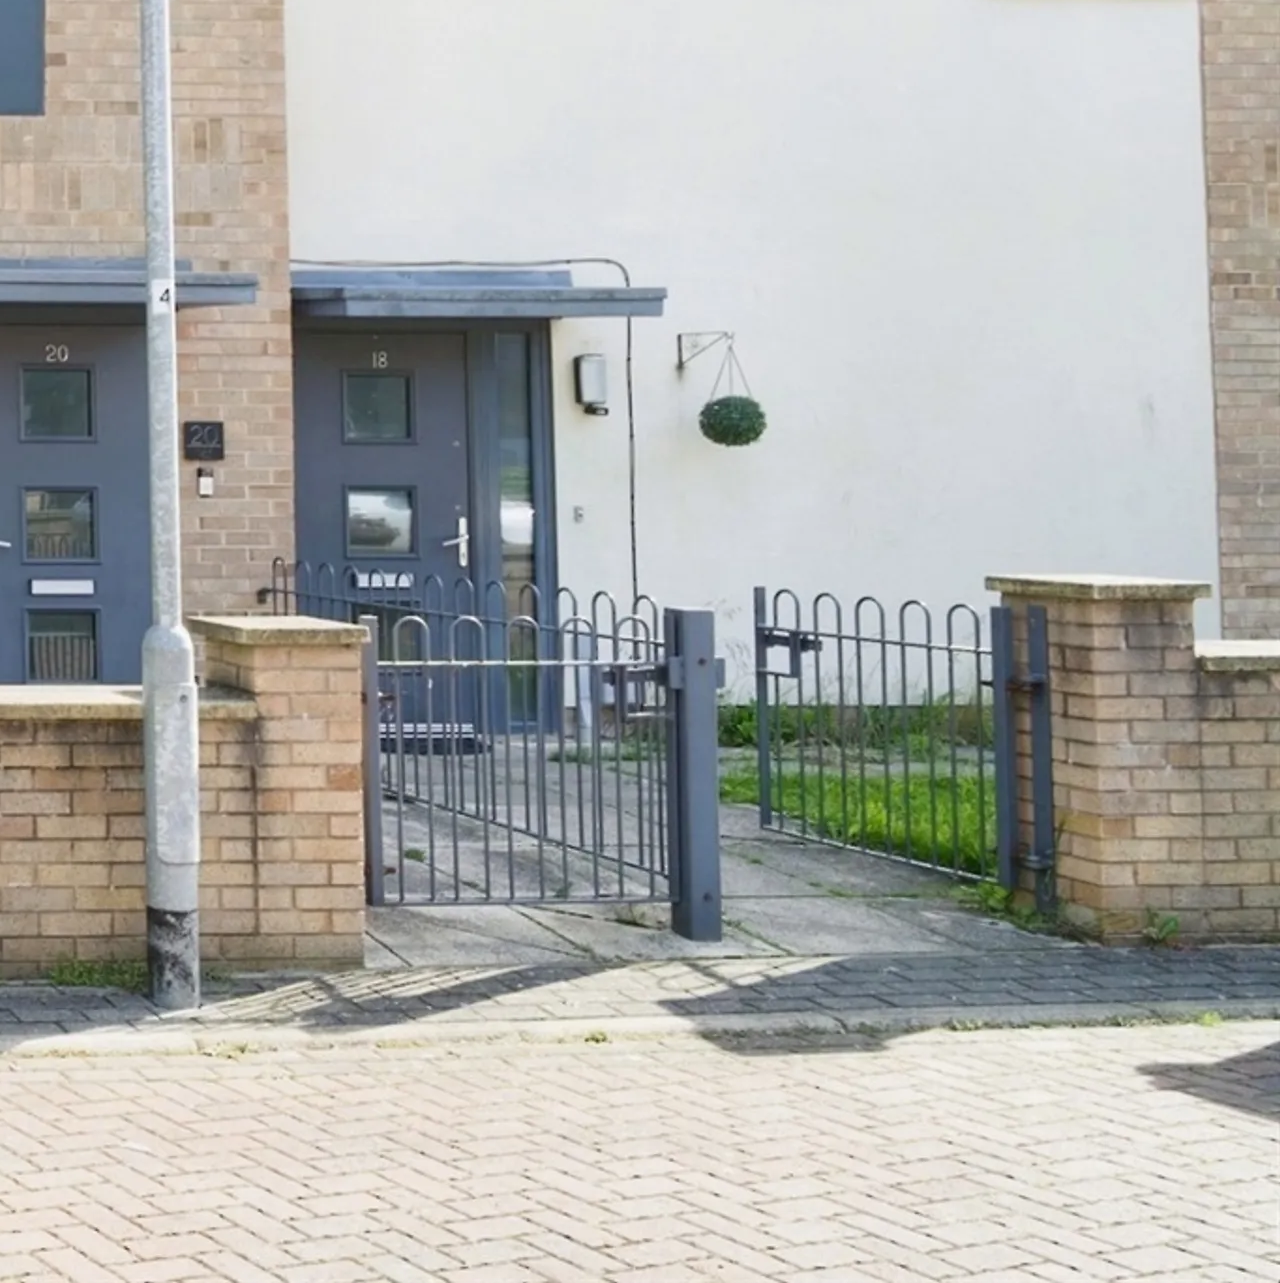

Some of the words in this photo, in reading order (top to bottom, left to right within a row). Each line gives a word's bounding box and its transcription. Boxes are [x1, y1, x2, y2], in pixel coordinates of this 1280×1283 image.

[159, 287, 171, 302] 4
[45, 343, 69, 362] 20
[372, 350, 389, 369] 18
[189, 424, 219, 447] 20
